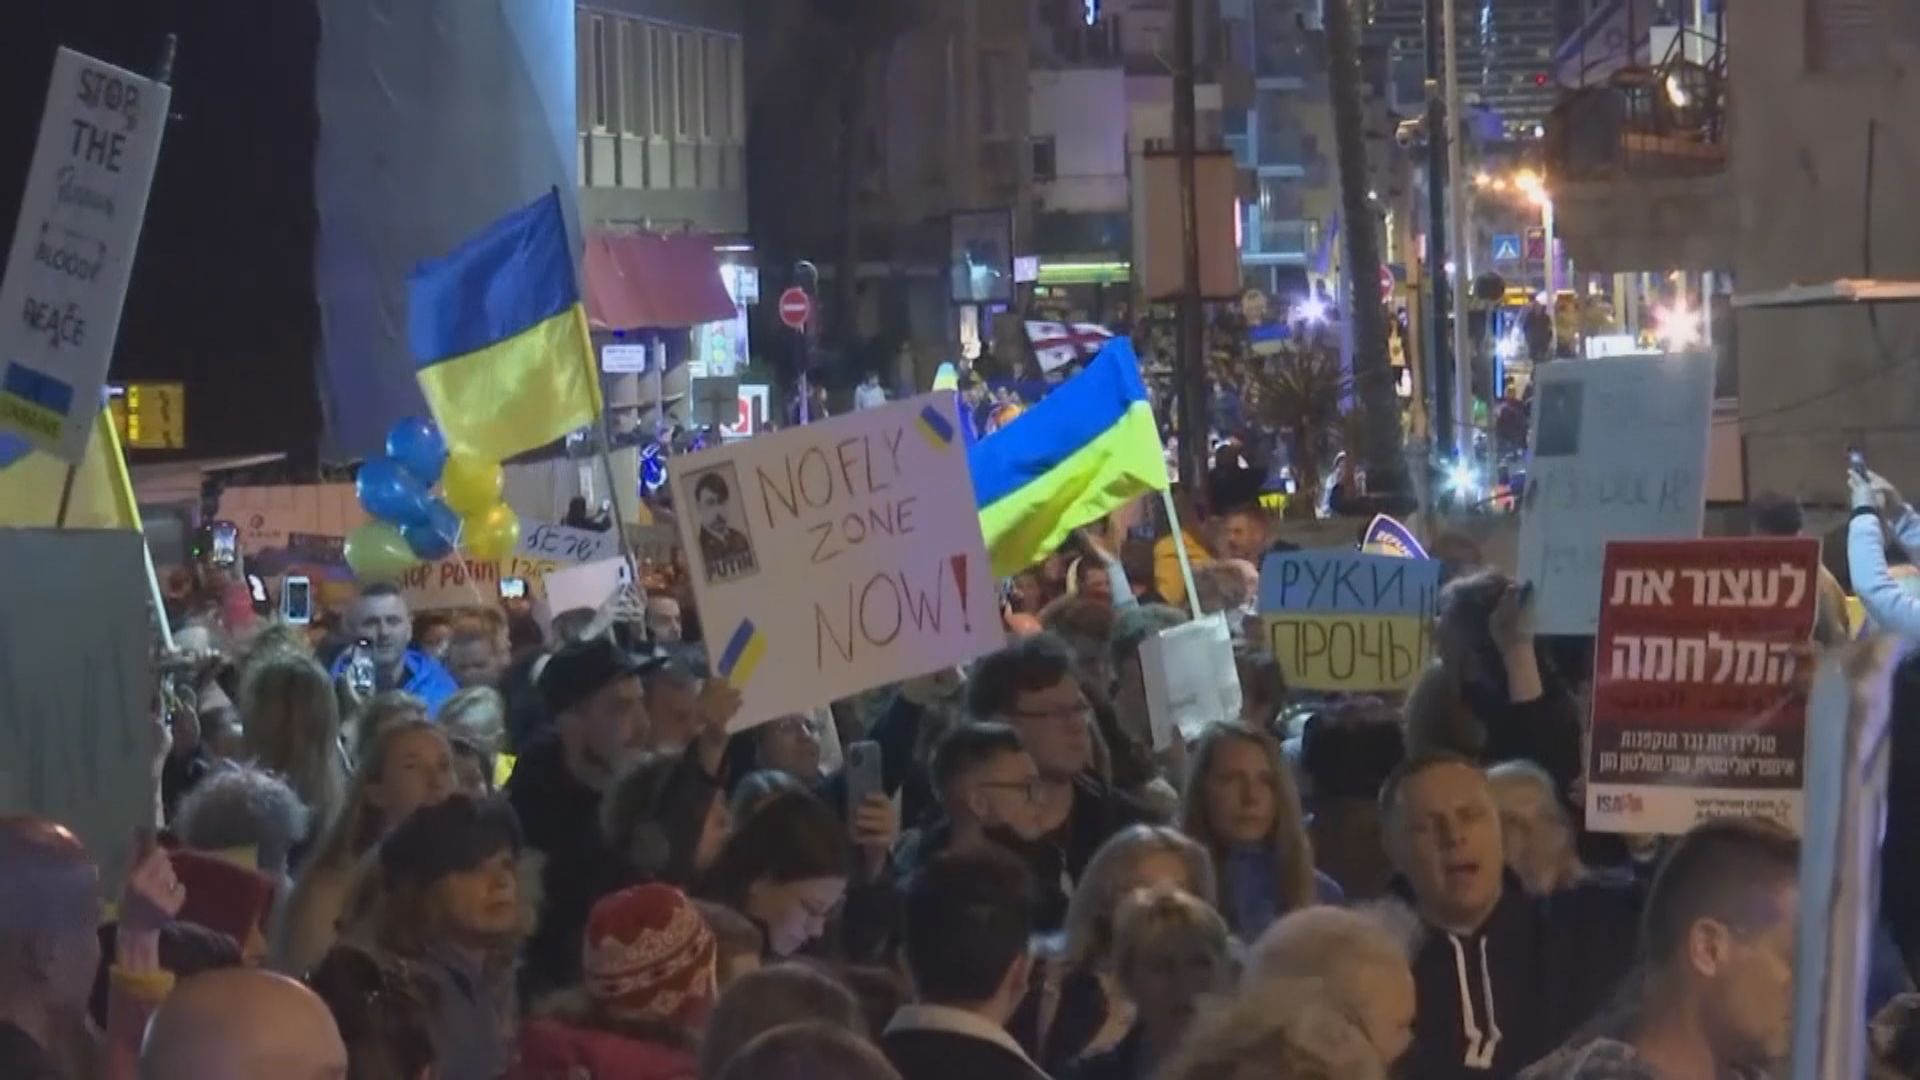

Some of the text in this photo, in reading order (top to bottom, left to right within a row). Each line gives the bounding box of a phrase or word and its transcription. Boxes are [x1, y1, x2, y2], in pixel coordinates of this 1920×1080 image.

[71, 118, 127, 173] THE
[756, 426, 903, 529] NO FLY
[807, 496, 917, 564] ZONE
[704, 552, 754, 581] PUTIN
[1280, 559, 1405, 609] РУКИ
[1610, 562, 1807, 608] לעצור את
[814, 553, 972, 672] NOW!
[1611, 631, 1797, 685] המלחמה
